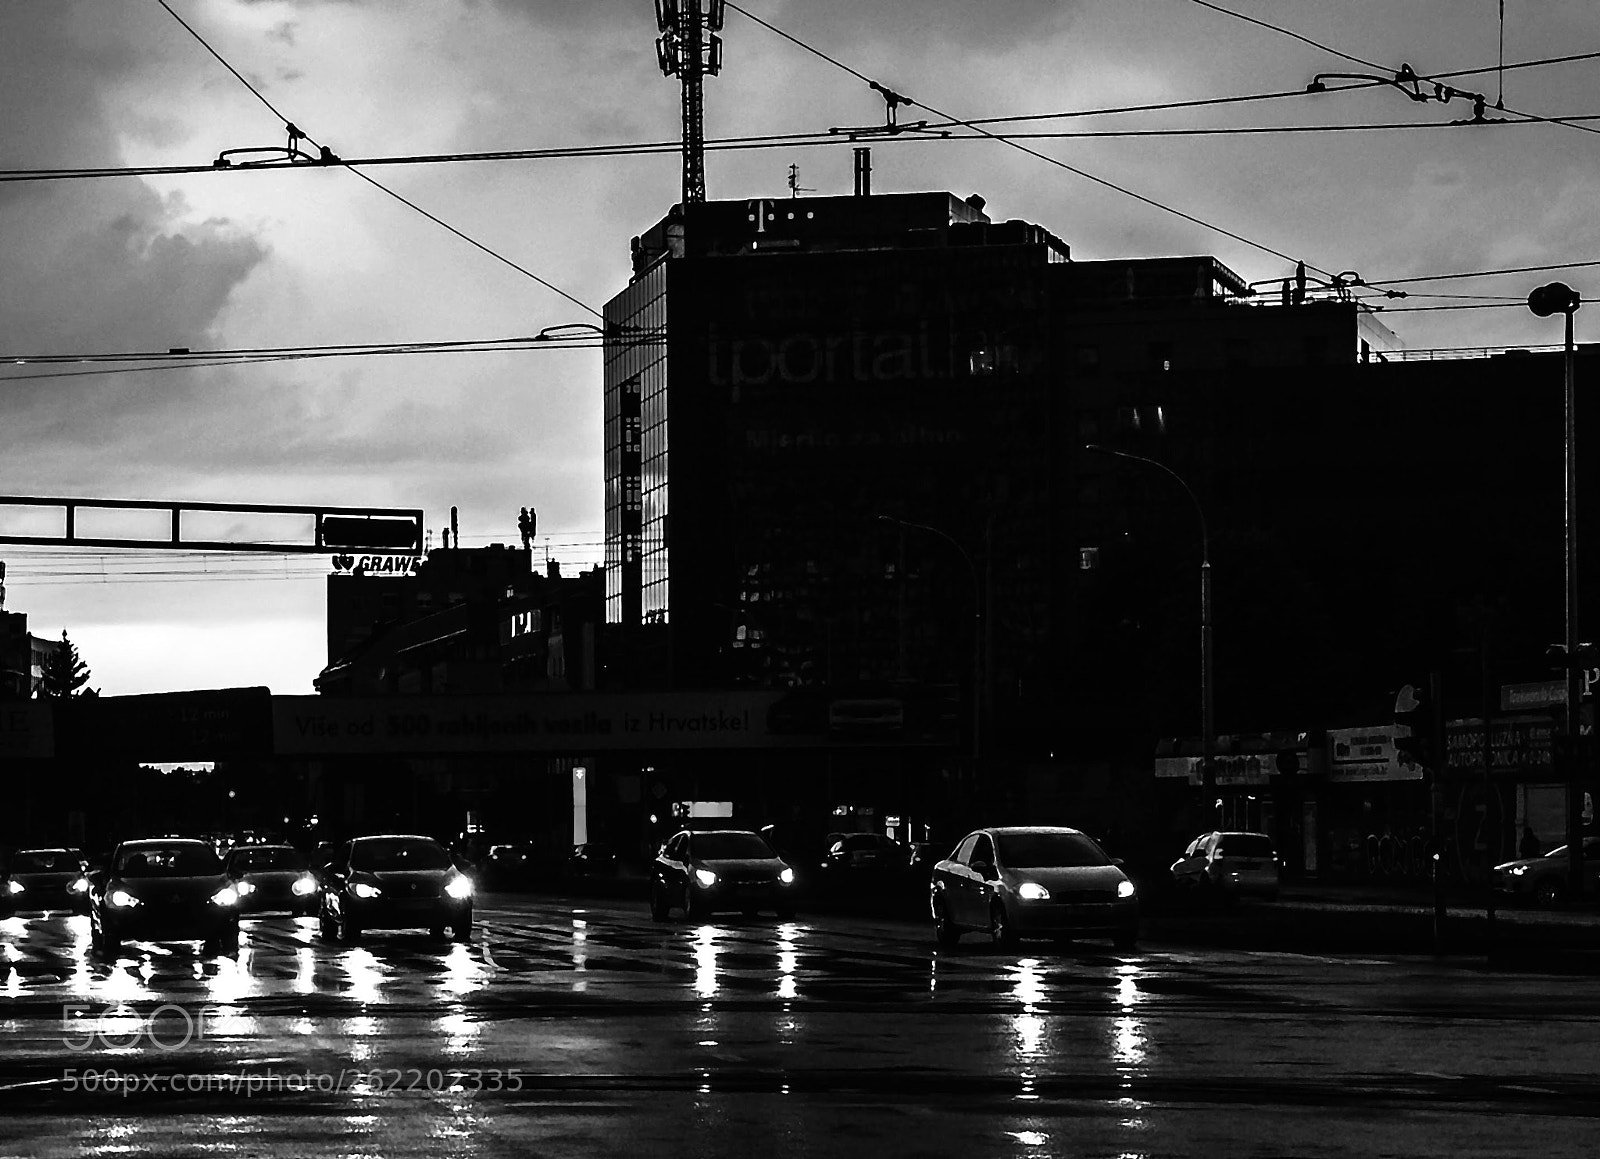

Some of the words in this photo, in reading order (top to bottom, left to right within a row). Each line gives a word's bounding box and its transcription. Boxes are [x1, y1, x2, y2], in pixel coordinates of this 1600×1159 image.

[295, 714, 338, 737] Više
[346, 714, 374, 736] od
[387, 713, 431, 736] 500
[624, 712, 641, 733] iz
[650, 709, 749, 732] Hrvatske!
